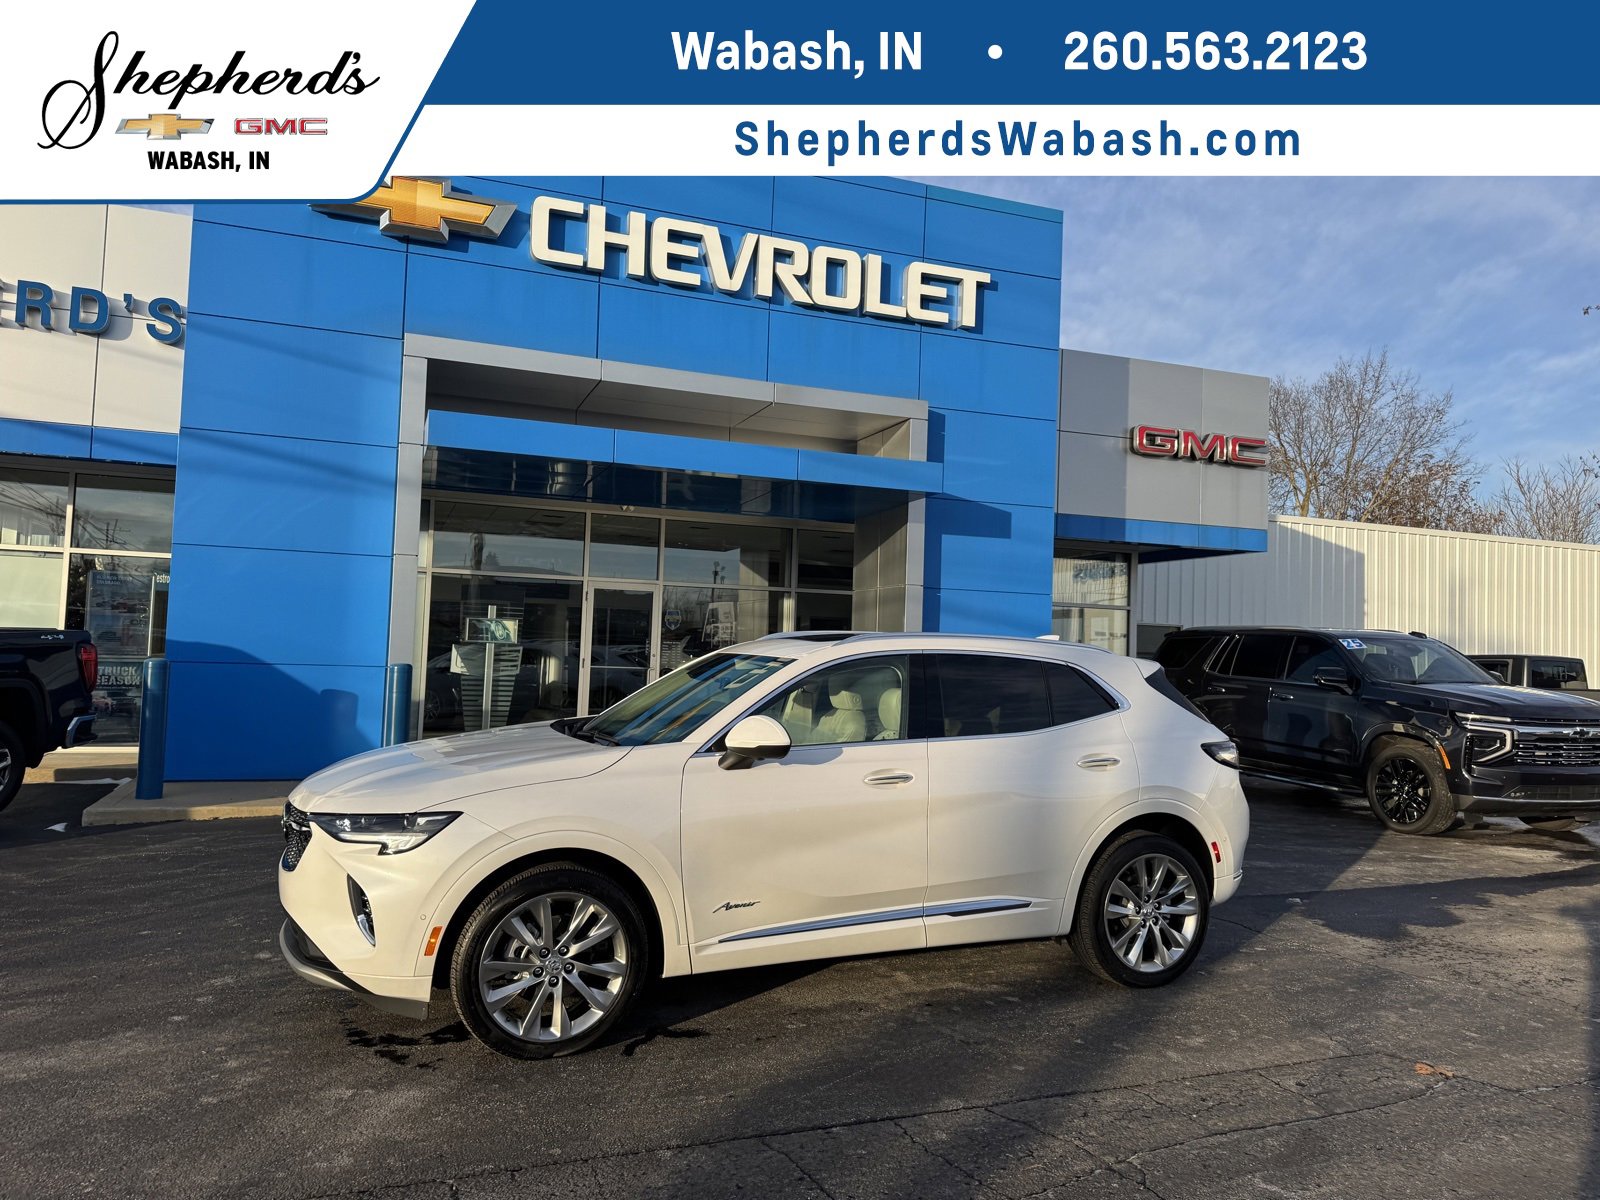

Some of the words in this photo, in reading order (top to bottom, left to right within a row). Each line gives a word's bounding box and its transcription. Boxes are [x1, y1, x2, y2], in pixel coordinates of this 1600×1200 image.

[530, 196, 991, 329] CHEVROLET
[0, 279, 183, 344] RD'S
[1132, 424, 1267, 467] GMC
[154, 572, 171, 584] estro
[1341, 639, 1364, 649] 25
[97, 666, 137, 676] TRUCK
